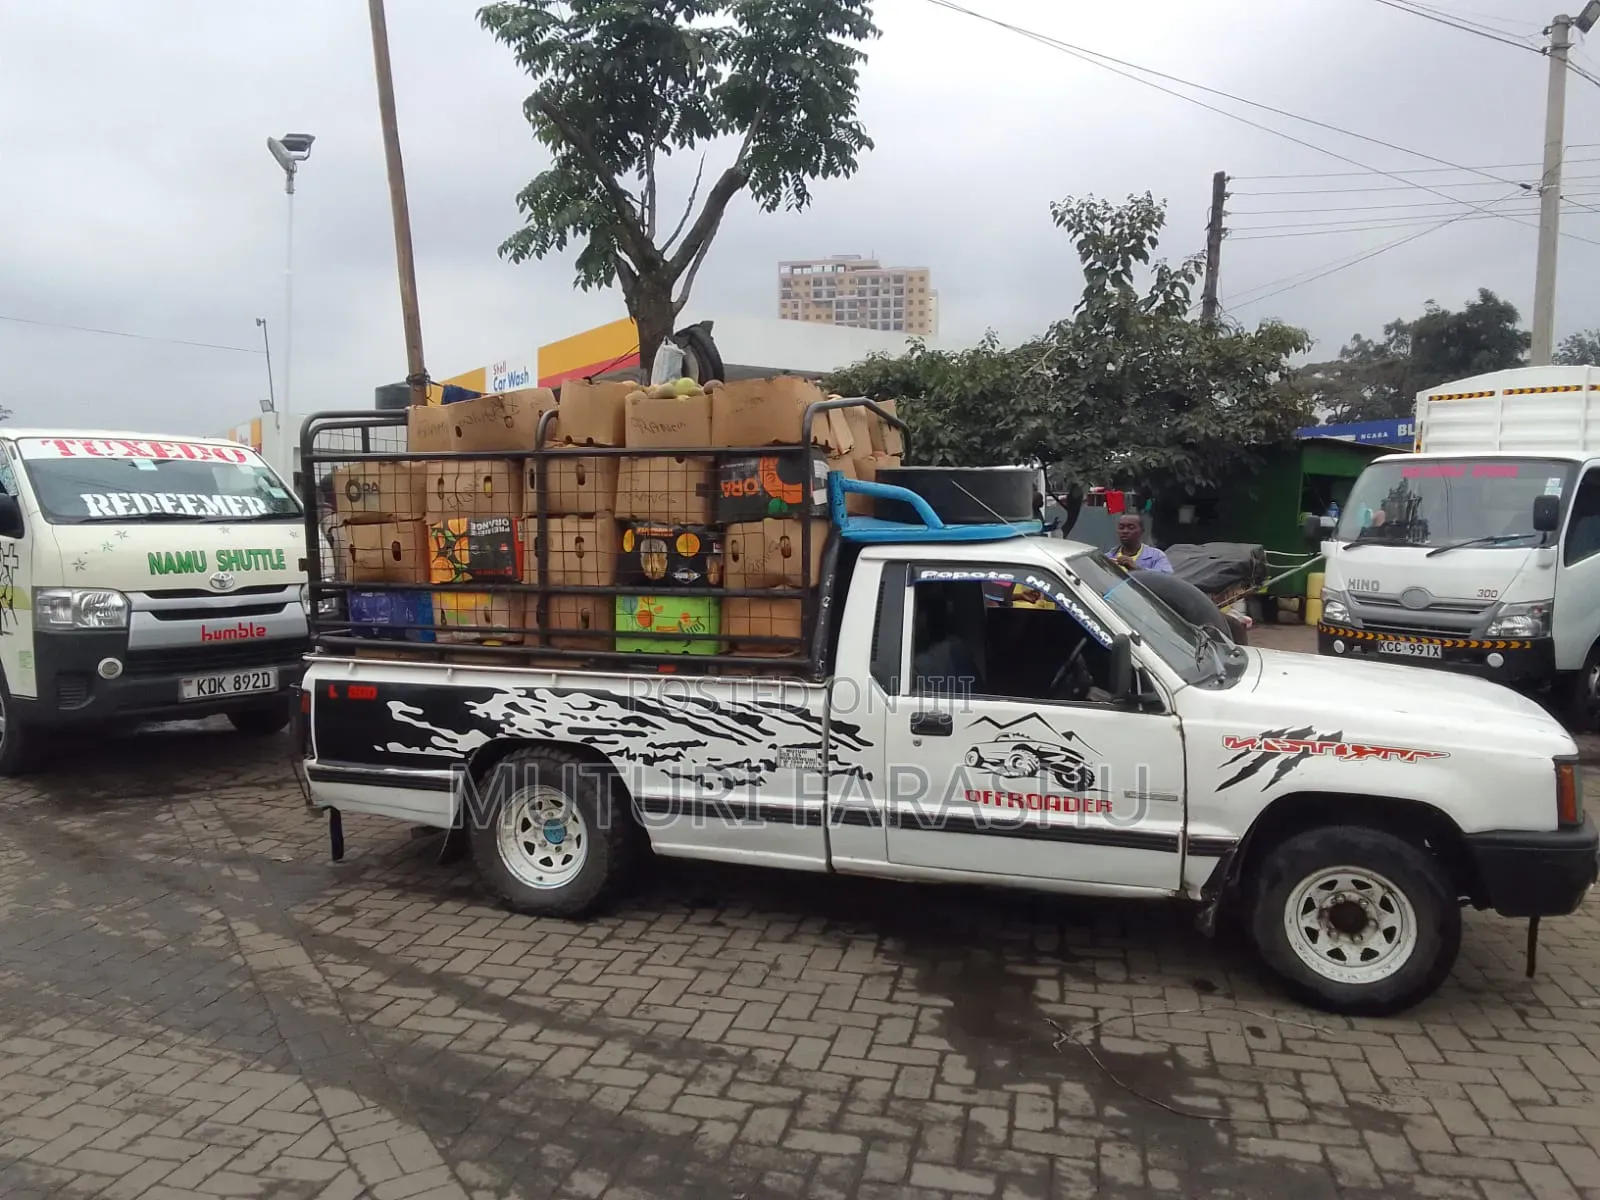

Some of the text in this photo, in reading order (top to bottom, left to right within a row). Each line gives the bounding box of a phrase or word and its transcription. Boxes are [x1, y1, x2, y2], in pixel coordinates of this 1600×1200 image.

[493, 360, 507, 375] Shell
[493, 365, 529, 392] Car Wash
[41, 438, 248, 464] TUXEDO
[80, 492, 267, 518] REDEEMER
[147, 548, 287, 576] NAMU SHUTTLE
[1347, 578, 1380, 592] HINO
[1476, 588, 1498, 599] 300
[1379, 640, 1441, 658] KCC 991X
[196, 672, 271, 696] KDK 892D
[965, 790, 1113, 813] OFFROADER
